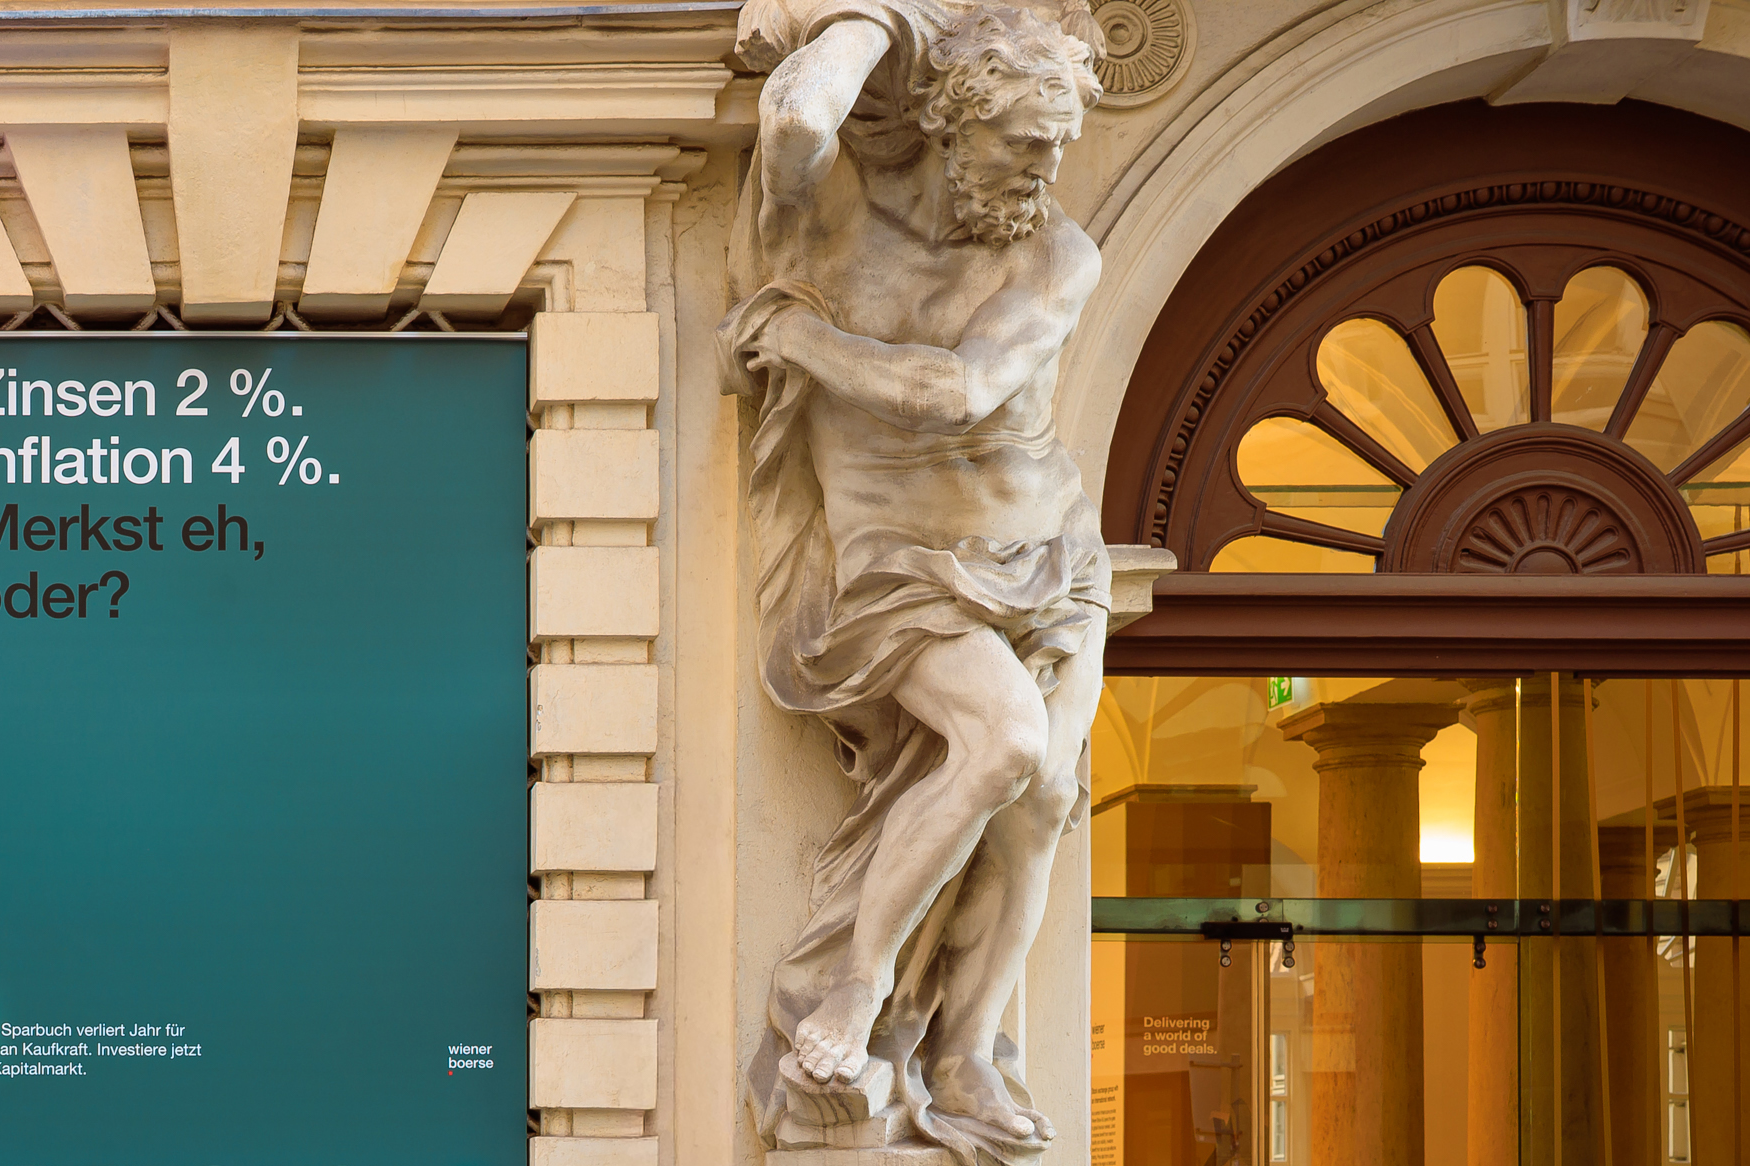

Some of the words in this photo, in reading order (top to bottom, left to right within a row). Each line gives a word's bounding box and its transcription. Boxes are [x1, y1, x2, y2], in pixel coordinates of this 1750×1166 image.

[176, 369, 208, 415] 2
[230, 368, 302, 417] %.
[212, 437, 245, 483] 4
[267, 436, 339, 485] %.
[182, 504, 264, 561] eh,
[2, 1023, 71, 1039] Sparbuch
[77, 1024, 125, 1036] verliert
[130, 1024, 161, 1036] Jahr
[166, 1024, 185, 1036] für
[1144, 1017, 1209, 1031] Delivering
[1155, 1030, 1190, 1041] world
[1194, 1031, 1207, 1040] of
[0, 1046, 17, 1055] an
[23, 1043, 91, 1055] Kaufkraft.
[98, 1043, 167, 1056] Investiere
[171, 1043, 201, 1059] jetzt
[448, 1044, 492, 1055] wiener
[1144, 1043, 1176, 1055] good
[1180, 1043, 1217, 1054] deals.
[449, 1057, 494, 1068] boerse
